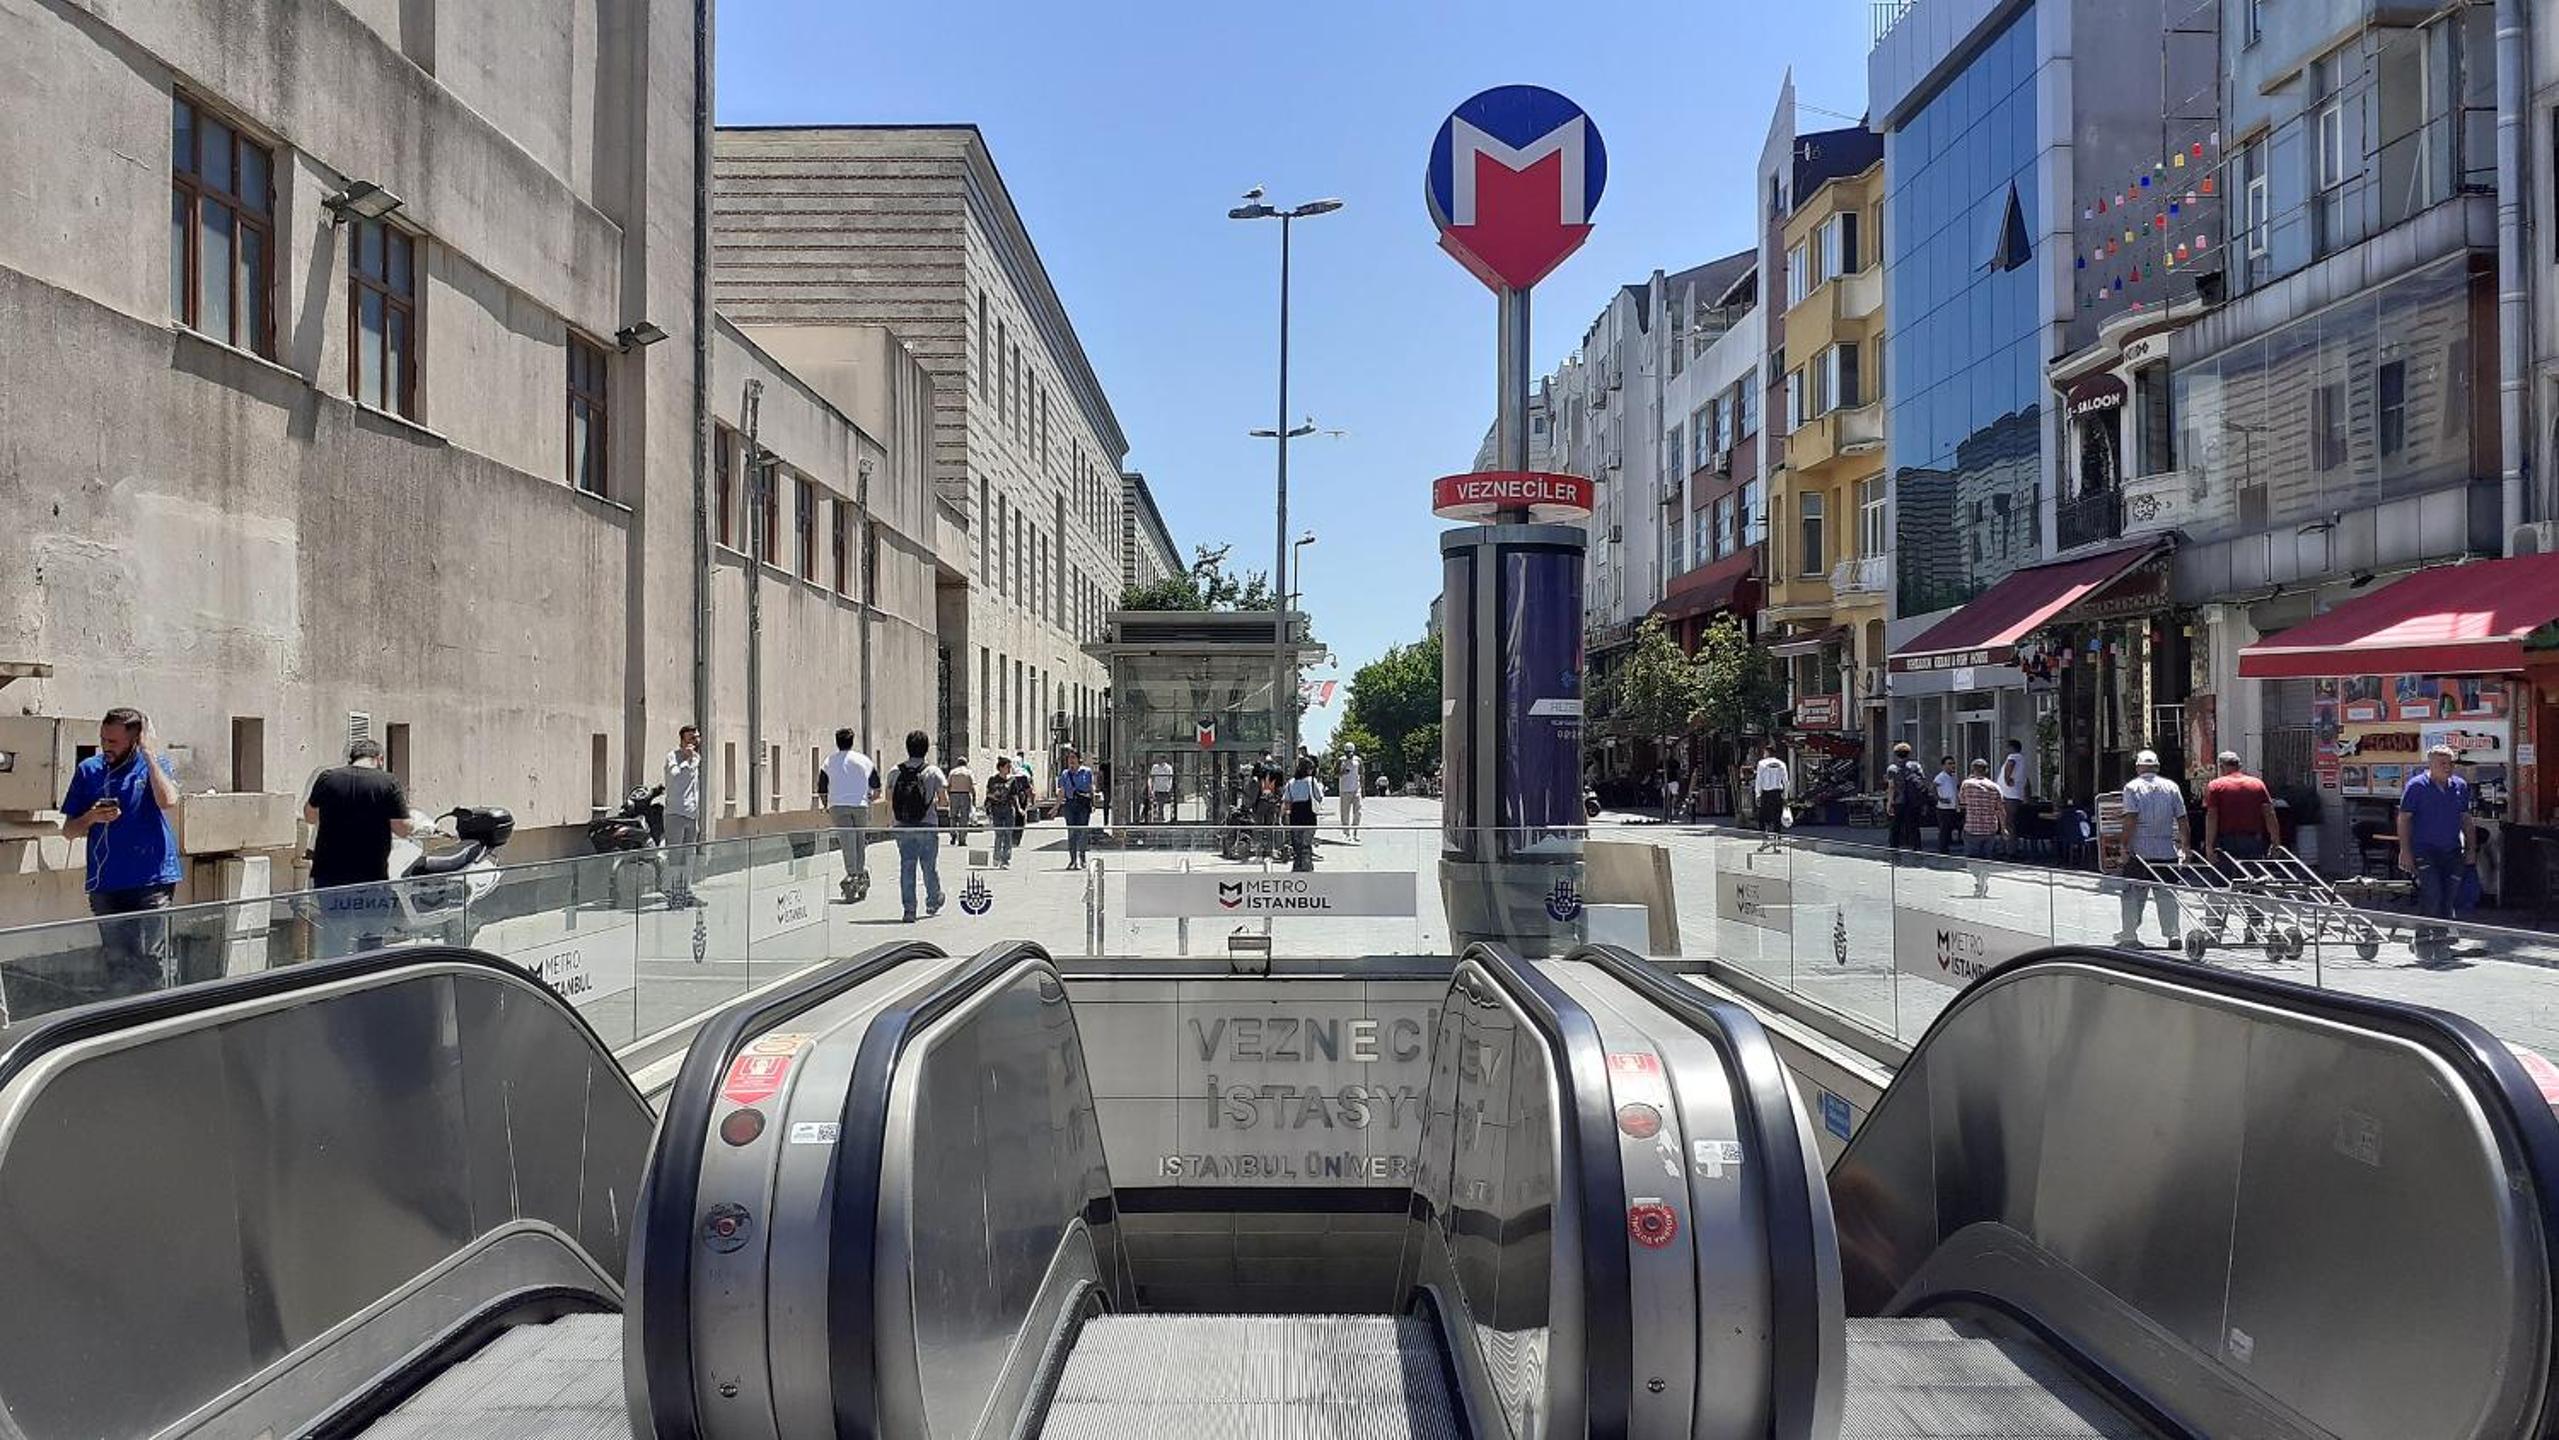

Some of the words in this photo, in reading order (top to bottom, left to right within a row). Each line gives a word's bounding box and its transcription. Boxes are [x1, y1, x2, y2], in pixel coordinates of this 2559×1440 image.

[2078, 393, 2120, 414] SALOON
[1457, 477, 1577, 501] VEZNECİLER
[1246, 880, 1308, 893] METRO
[1247, 895, 1332, 909] İSTANBUL
[1951, 930, 1983, 956] METRO
[545, 949, 580, 977] METRO
[1951, 952, 1992, 980] İSTANB
[1207, 1075, 1427, 1130] İSTASY
